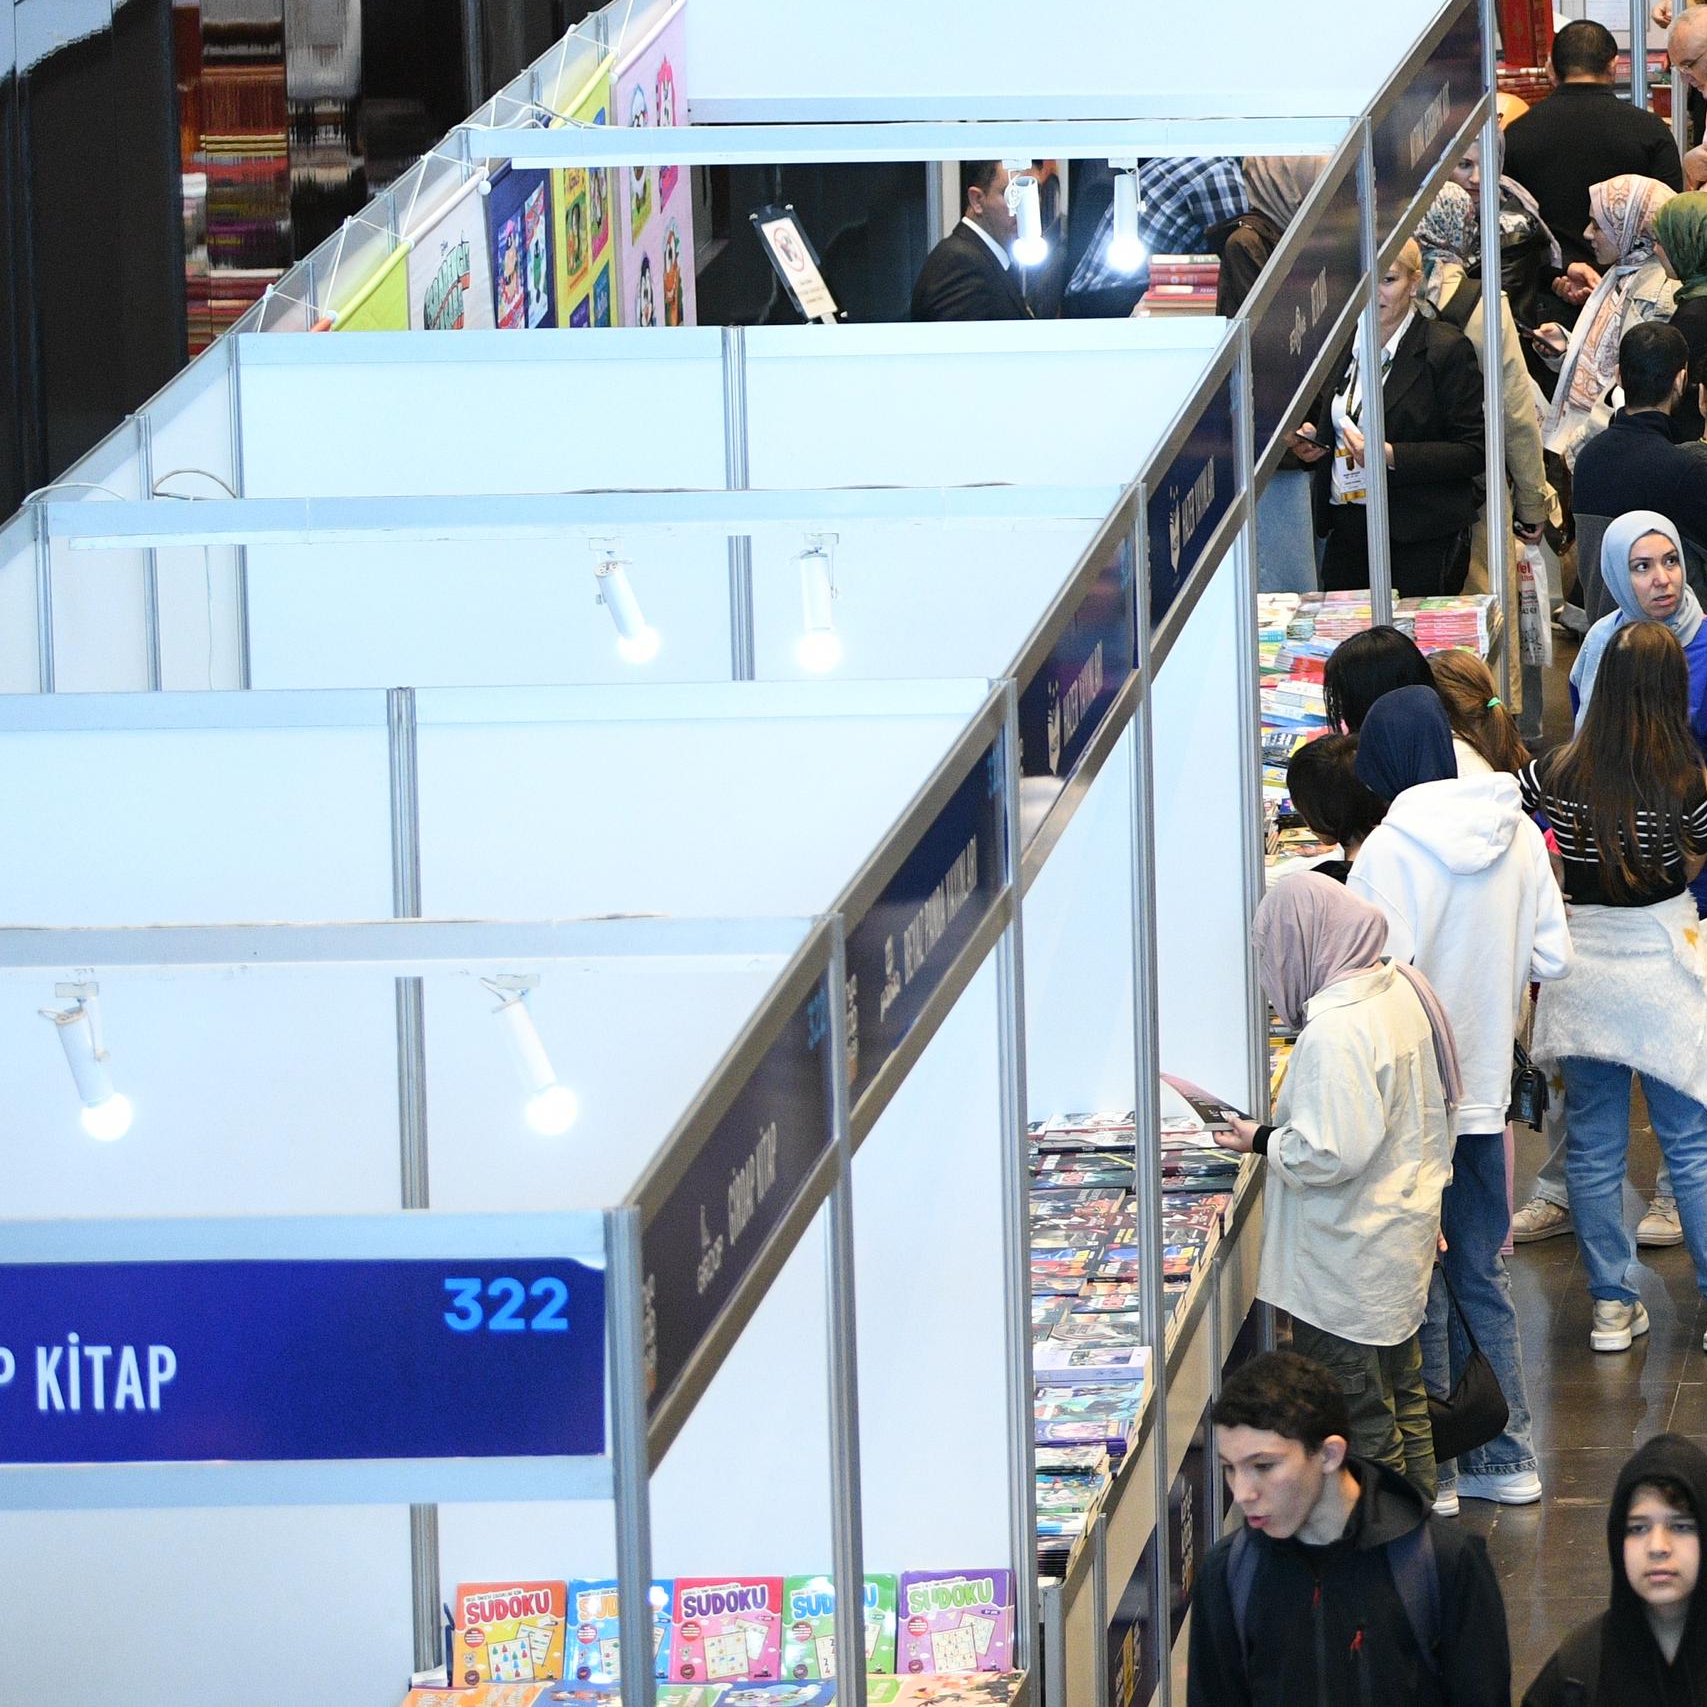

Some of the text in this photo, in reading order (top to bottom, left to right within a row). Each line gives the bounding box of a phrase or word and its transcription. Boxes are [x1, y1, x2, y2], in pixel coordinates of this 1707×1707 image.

[728, 1121, 777, 1246] GİRDAP KİTAP
[443, 1276, 568, 1330] 322
[36, 1331, 178, 1412] KİTAP
[466, 1590, 550, 1625] SUDOKU
[684, 1585, 766, 1617] SUDOKU
[791, 1584, 877, 1619] SUDU
[909, 1579, 993, 1614] SUDOKU
